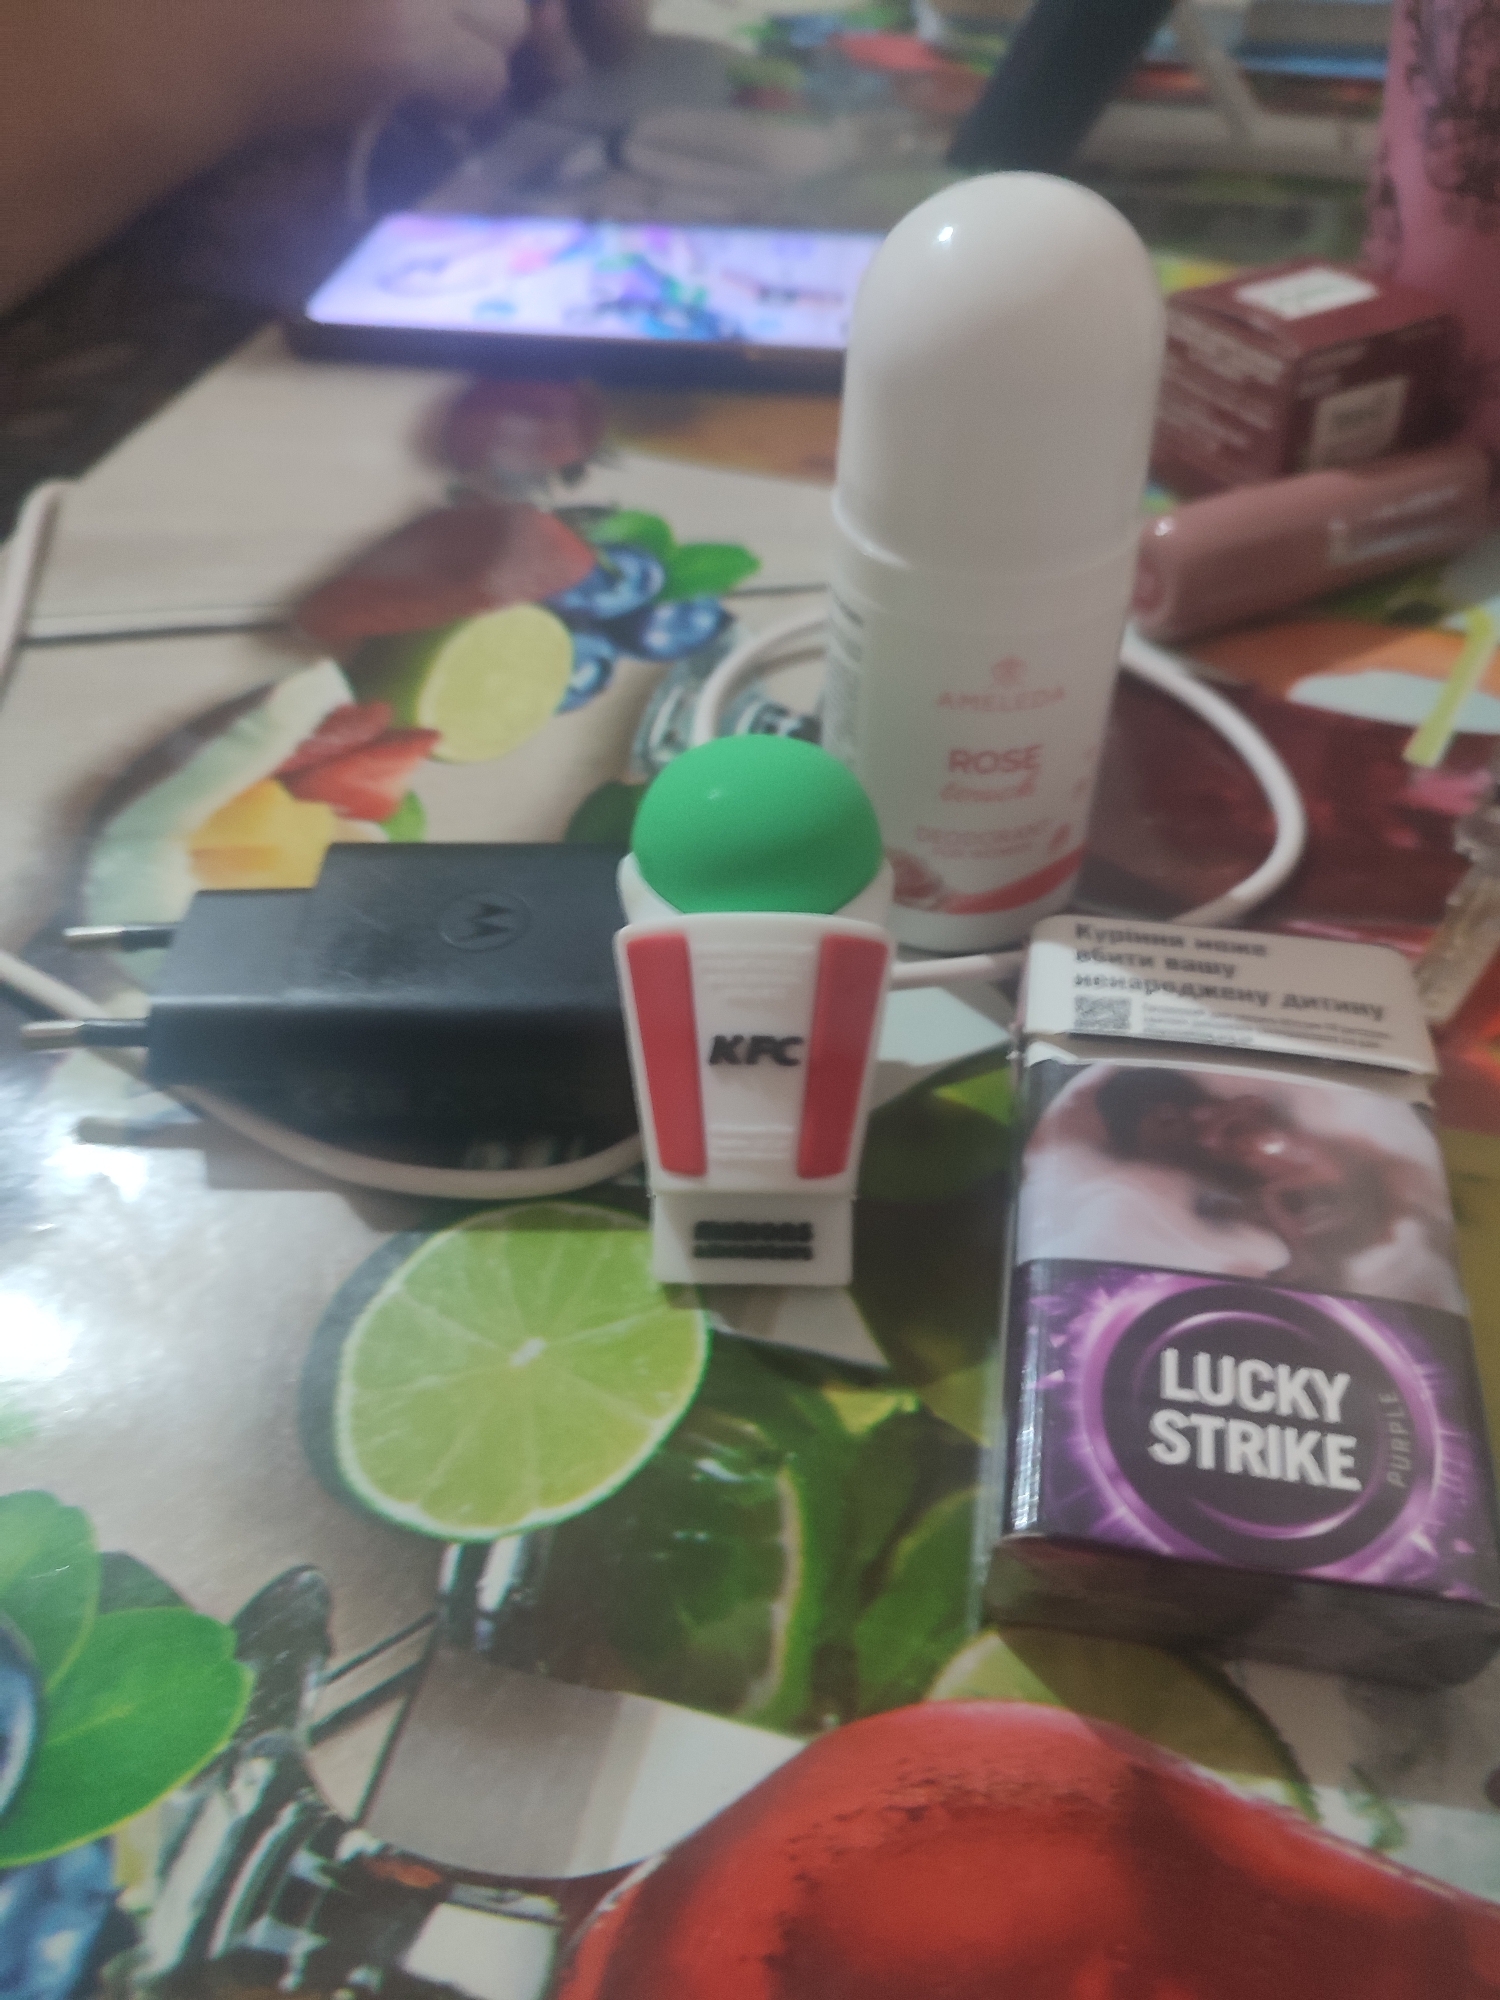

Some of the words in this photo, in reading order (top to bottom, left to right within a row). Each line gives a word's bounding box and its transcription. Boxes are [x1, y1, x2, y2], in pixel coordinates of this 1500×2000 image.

[948, 743, 1044, 774] ROSE
[1075, 923, 1185, 949] Куріння
[1194, 938, 1267, 957] може
[1075, 947, 1155, 968] вбити
[1165, 957, 1236, 979] вашу
[1073, 974, 1270, 1007] ненароджену
[1280, 993, 1385, 1021] дитину
[709, 1034, 804, 1067] KFC
[1160, 1347, 1351, 1424] LUCKY
[1147, 1408, 1362, 1492] STRIKE
[1377, 1391, 1413, 1490] PURPLE
